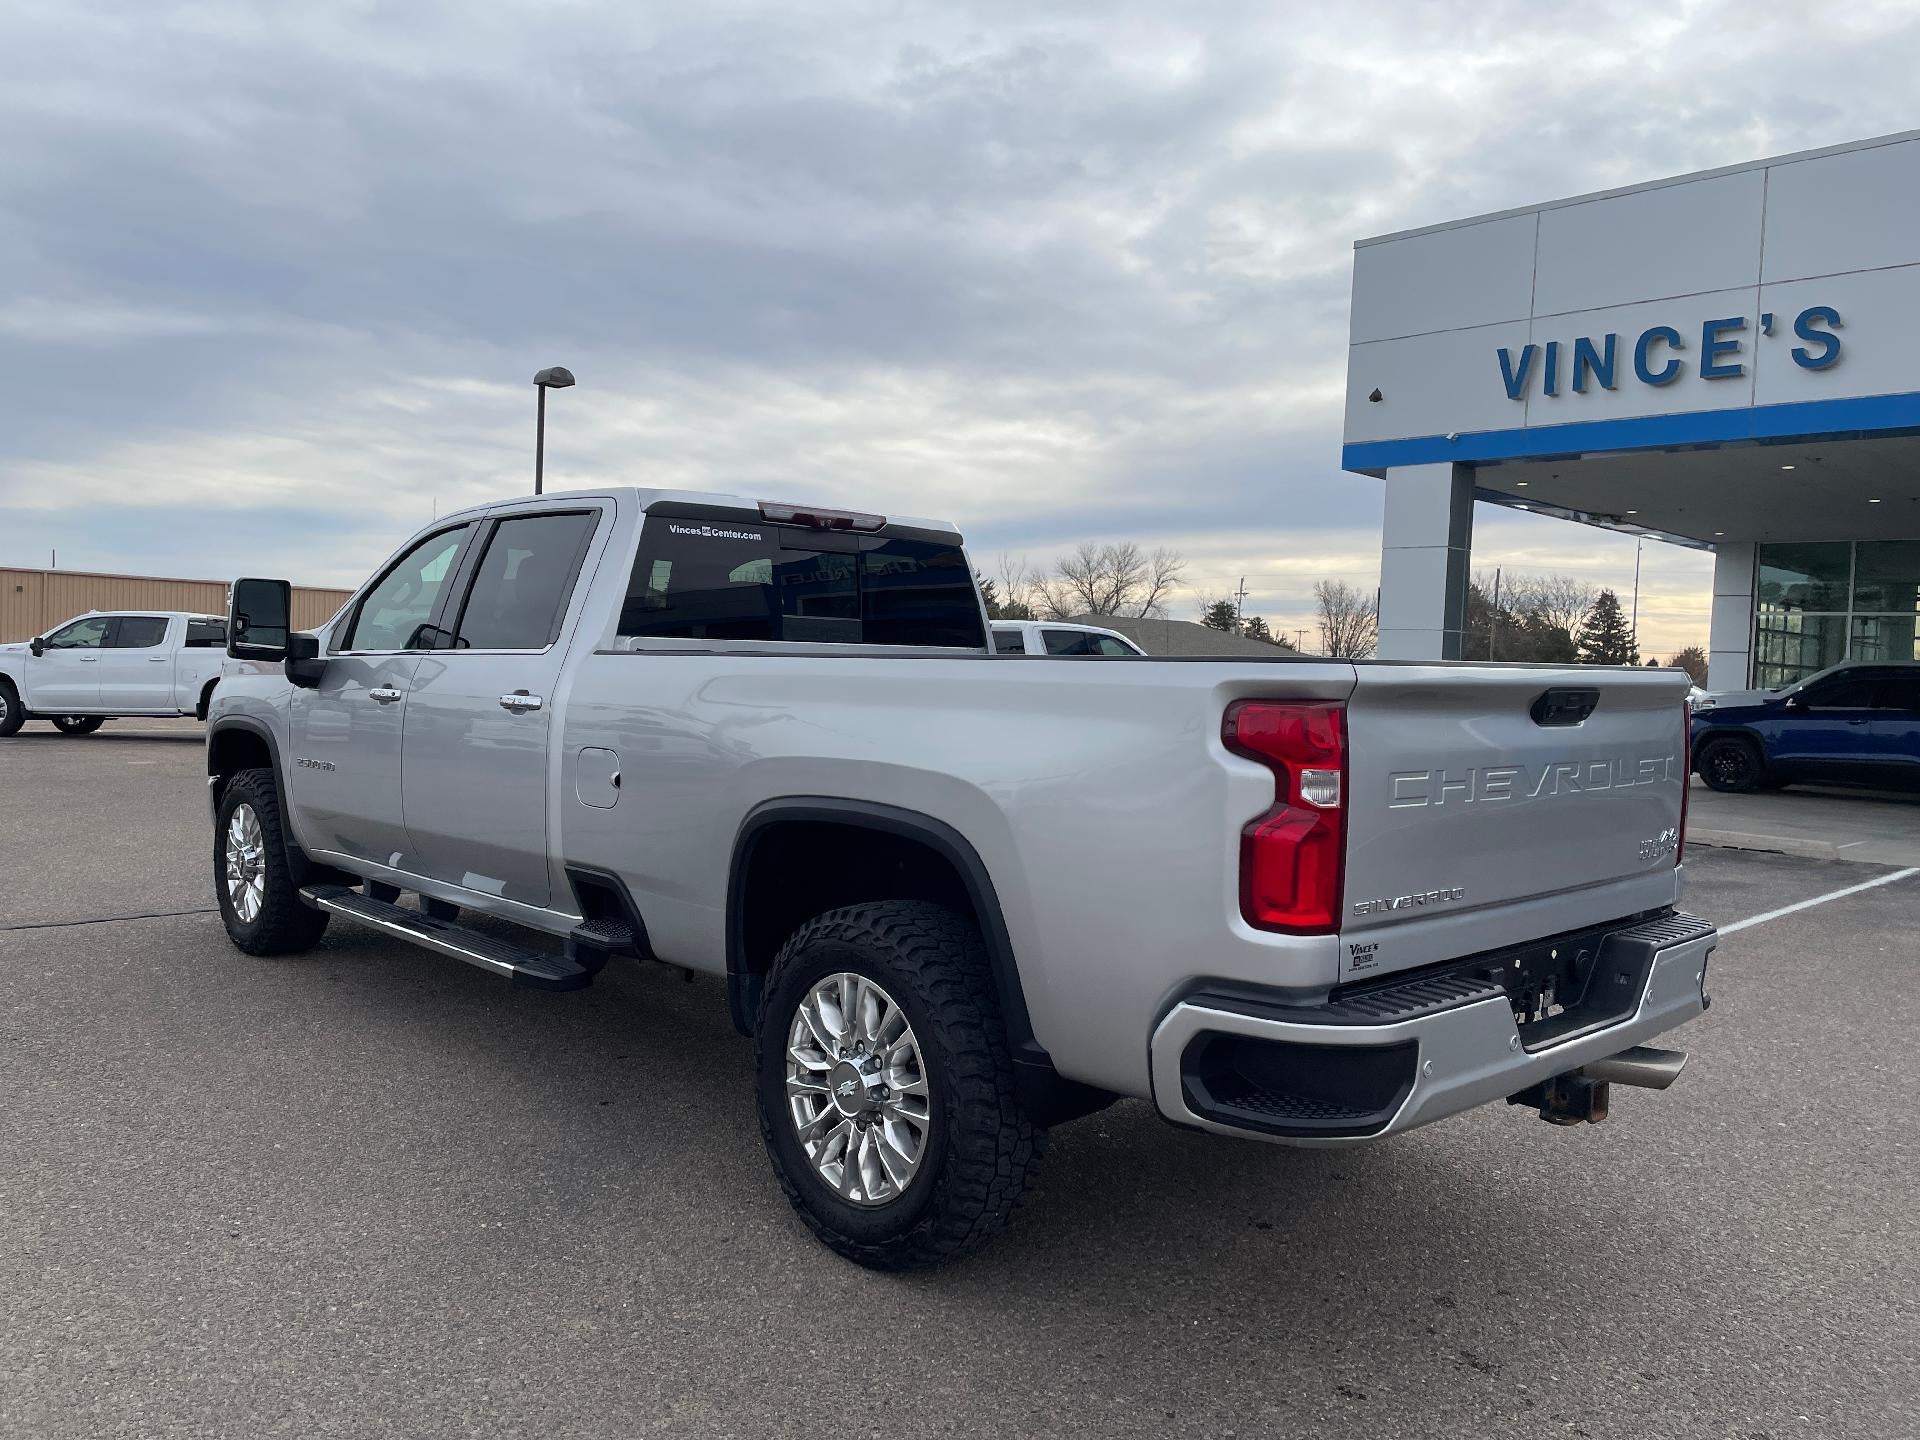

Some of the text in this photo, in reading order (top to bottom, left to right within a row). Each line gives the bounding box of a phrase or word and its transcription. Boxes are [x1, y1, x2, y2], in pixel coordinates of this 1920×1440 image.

[1497, 305, 1843, 400] VINCE'S
[1388, 755, 1676, 808] CHEVROLET
[1353, 887, 1465, 916] SILVERADO
